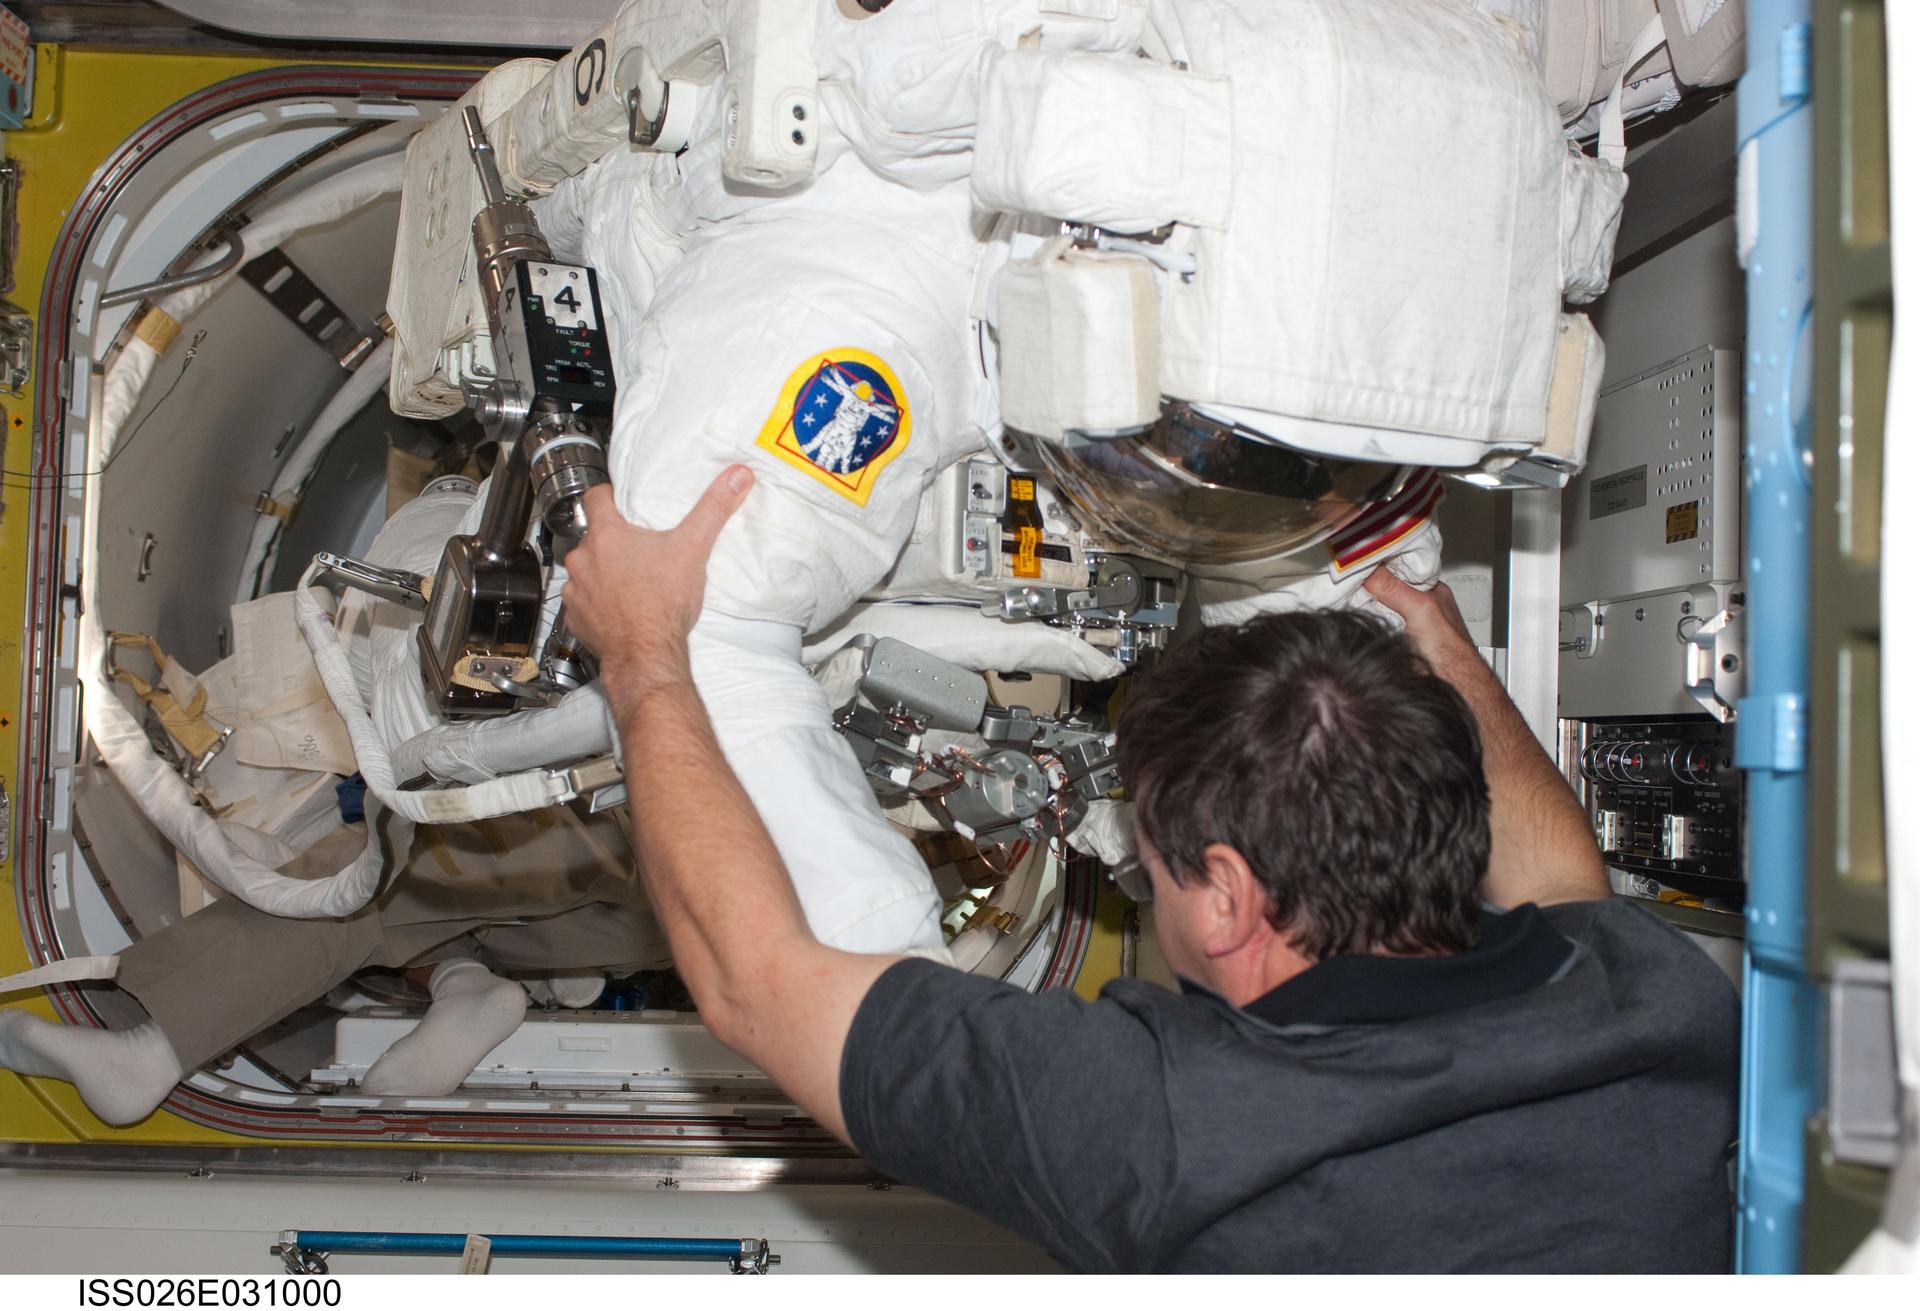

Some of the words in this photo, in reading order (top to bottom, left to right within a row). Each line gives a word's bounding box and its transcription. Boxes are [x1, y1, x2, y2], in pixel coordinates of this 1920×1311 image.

[554, 285, 581, 314] 4
[555, 328, 575, 336] FAULT
[568, 340, 592, 348] TORQUE
